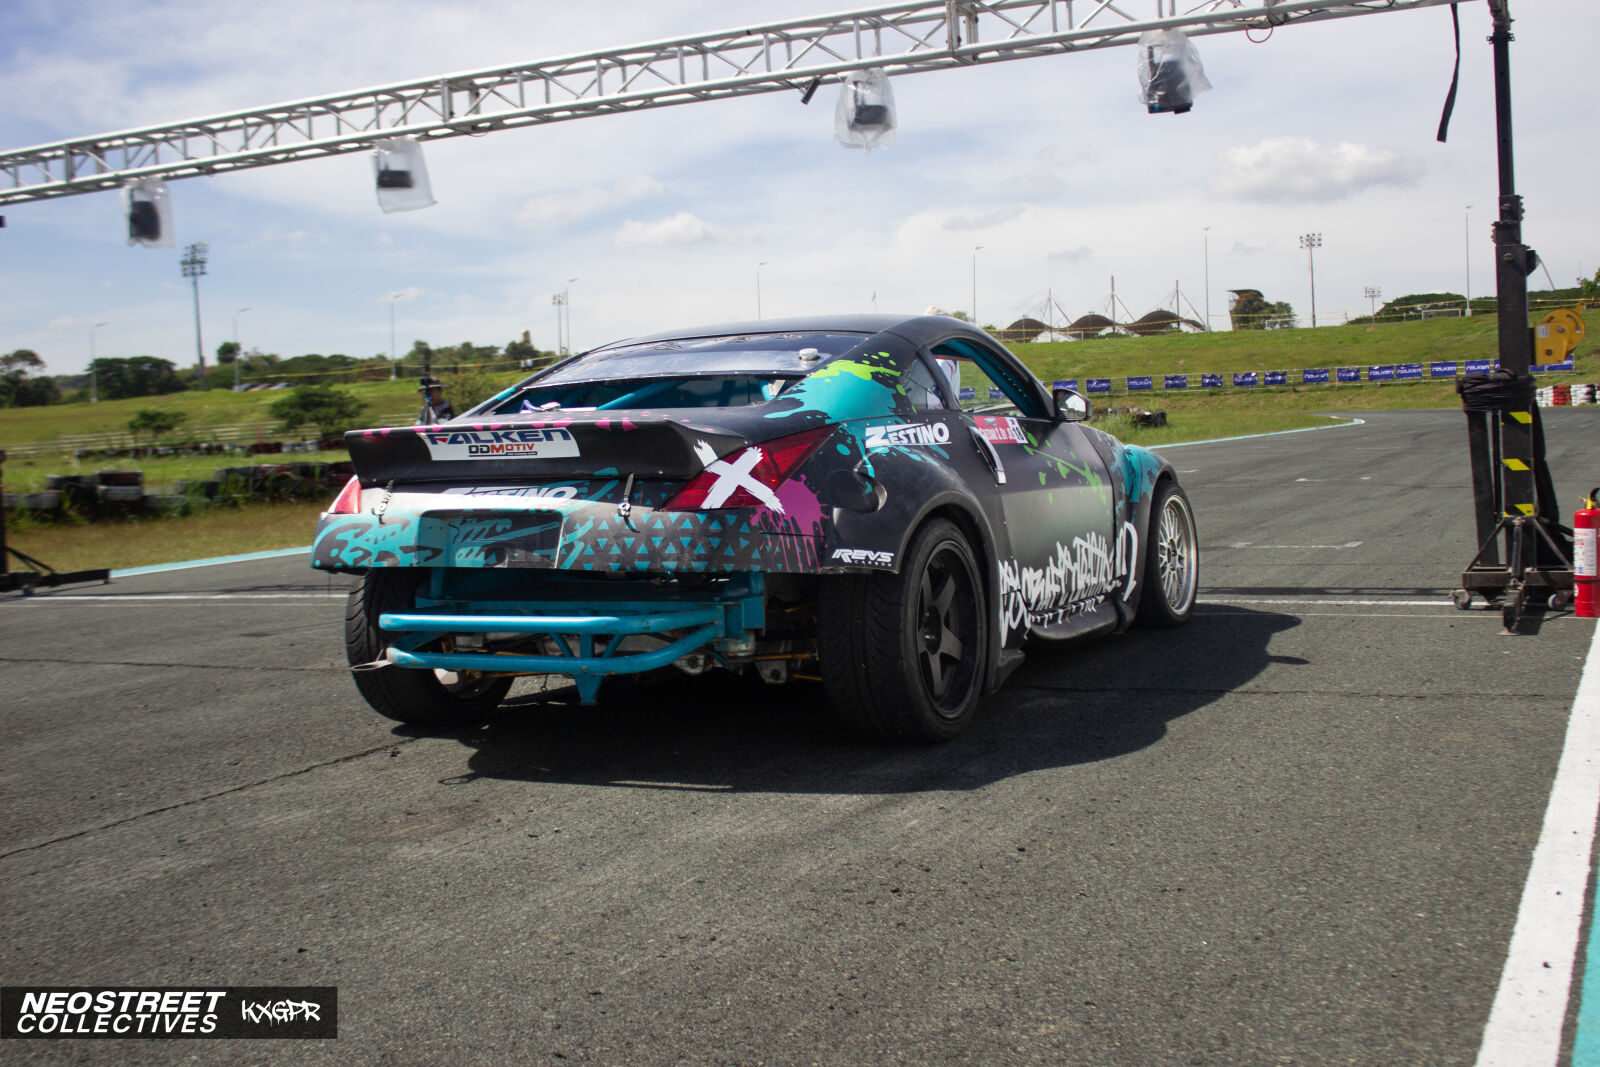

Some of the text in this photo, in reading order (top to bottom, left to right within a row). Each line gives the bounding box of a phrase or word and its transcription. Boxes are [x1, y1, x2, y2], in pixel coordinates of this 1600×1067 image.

[425, 429, 571, 445] FALKEN
[865, 422, 952, 448] ZESTINO
[831, 548, 895, 563] REVS
